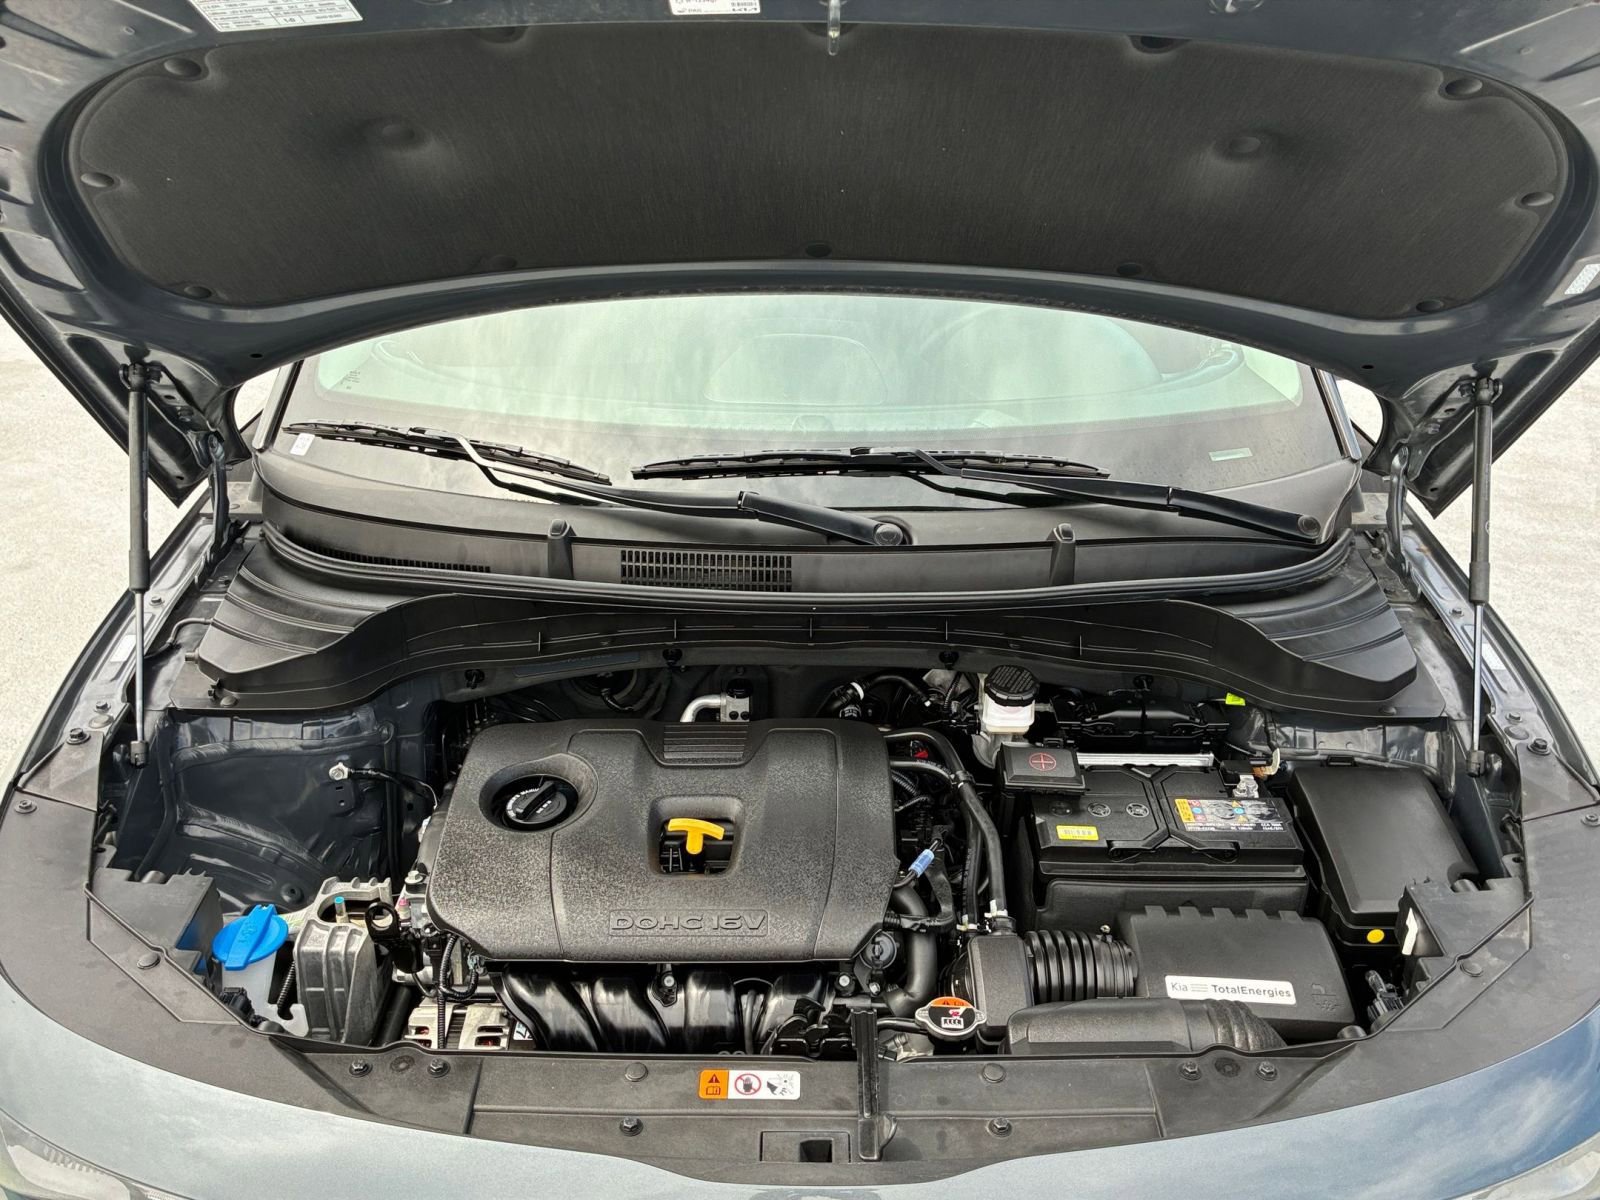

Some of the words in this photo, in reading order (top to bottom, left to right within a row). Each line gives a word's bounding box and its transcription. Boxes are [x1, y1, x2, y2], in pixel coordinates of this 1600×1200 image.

[611, 915, 703, 930] DOHC
[712, 915, 766, 930] 16V
[1170, 982, 1189, 992] Kia
[1211, 984, 1292, 998] TotalEnergies
